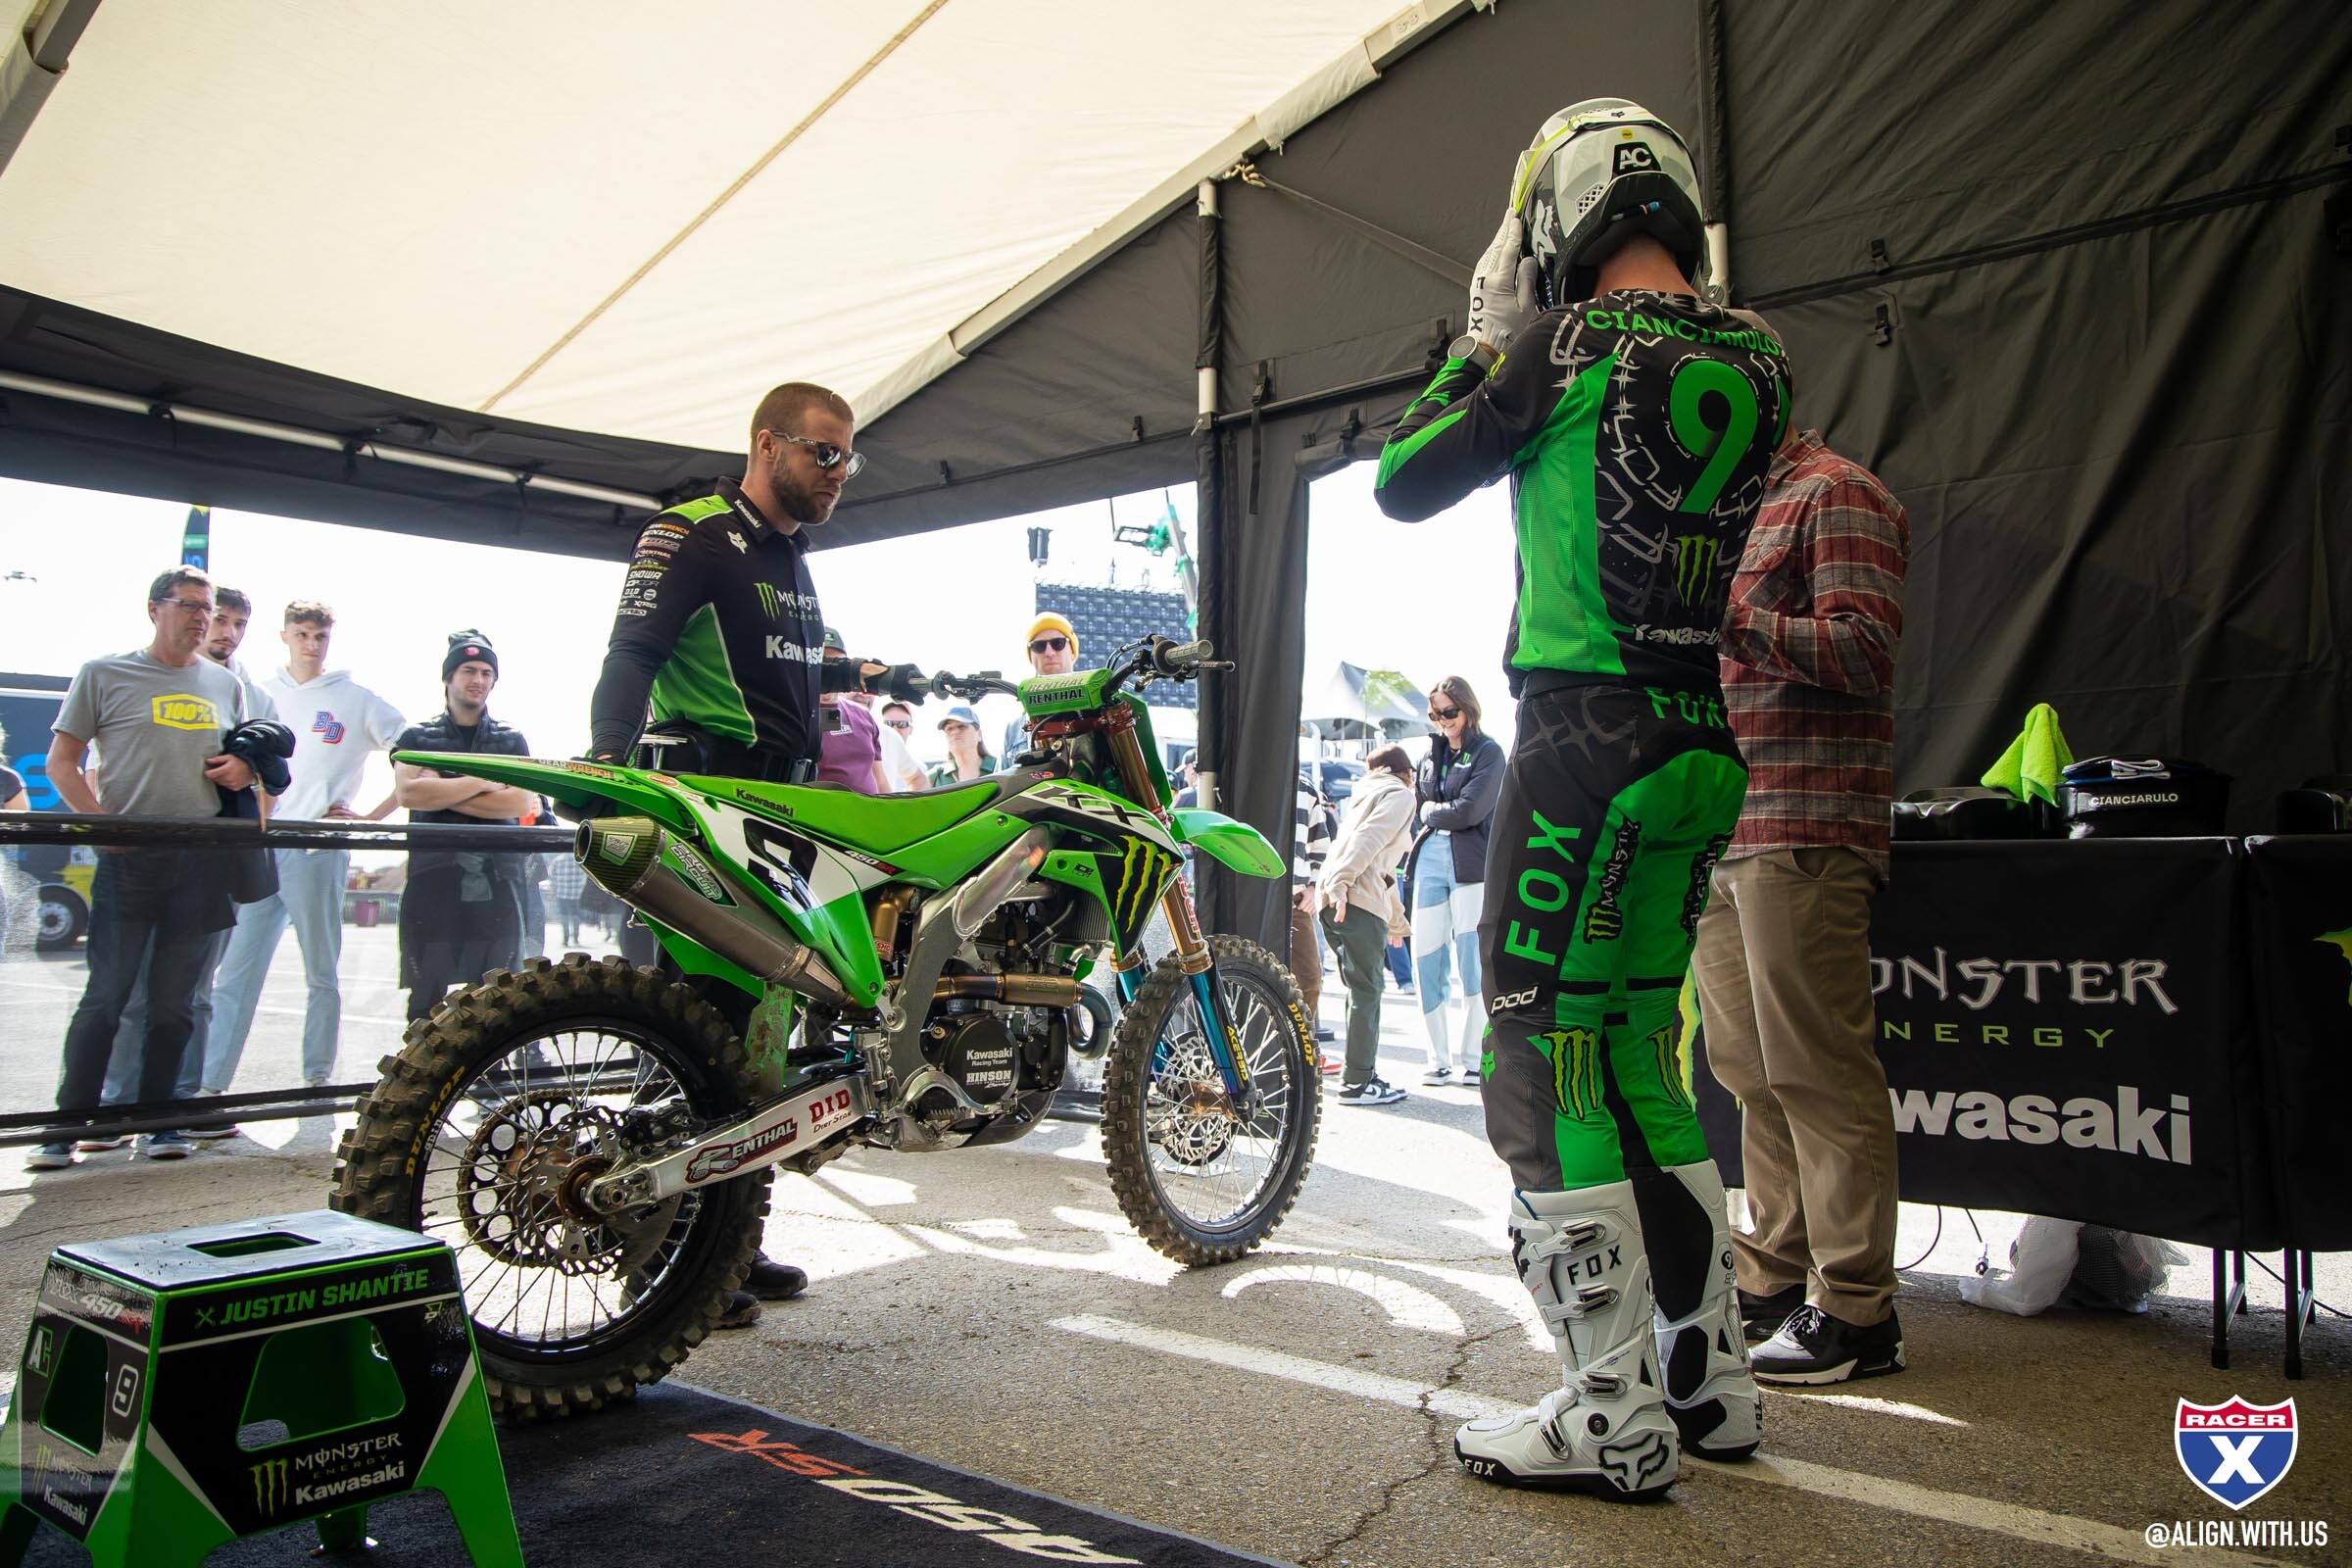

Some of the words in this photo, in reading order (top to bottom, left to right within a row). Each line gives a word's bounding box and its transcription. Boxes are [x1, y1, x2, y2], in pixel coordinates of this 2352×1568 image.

[1619, 147, 1651, 171] AC
[1470, 276, 1486, 333] FOX
[1586, 310, 1783, 357] CIANCIARULO
[1670, 360, 1757, 514] 9
[734, 499, 761, 528] Kawasaki
[628, 570, 662, 579] SHOWA
[163, 700, 213, 723] 100%
[1029, 688, 1086, 705] RENTHAL
[312, 711, 345, 745] BD
[736, 788, 794, 817] Kawasaki
[2090, 792, 2179, 808] CIANCIARULO
[669, 845, 719, 901] CIRCUIT
[1504, 809, 1582, 966] FOX
[1869, 946, 2180, 1015] ONSTER
[966, 1048, 1012, 1060] Kawasaki
[1289, 1004, 1314, 1066] DUNLOP
[1884, 1021, 2115, 1049] NERGY
[966, 1069, 1011, 1083] HINSON
[406, 1066, 466, 1176] DUNLOP
[1887, 1085, 2192, 1166] wasaki
[1567, 1245, 1623, 1286] FOX
[220, 1289, 317, 1326] JUSTIN
[322, 1269, 428, 1307] SHANTIE
[112, 1363, 140, 1417] 9
[295, 1432, 403, 1471] MONSTER
[314, 1454, 387, 1480] ENERGY
[1464, 1458, 1496, 1477] FOX
[296, 1460, 405, 1505] Kawasaki
[43, 1485, 88, 1526] Kawasaki
